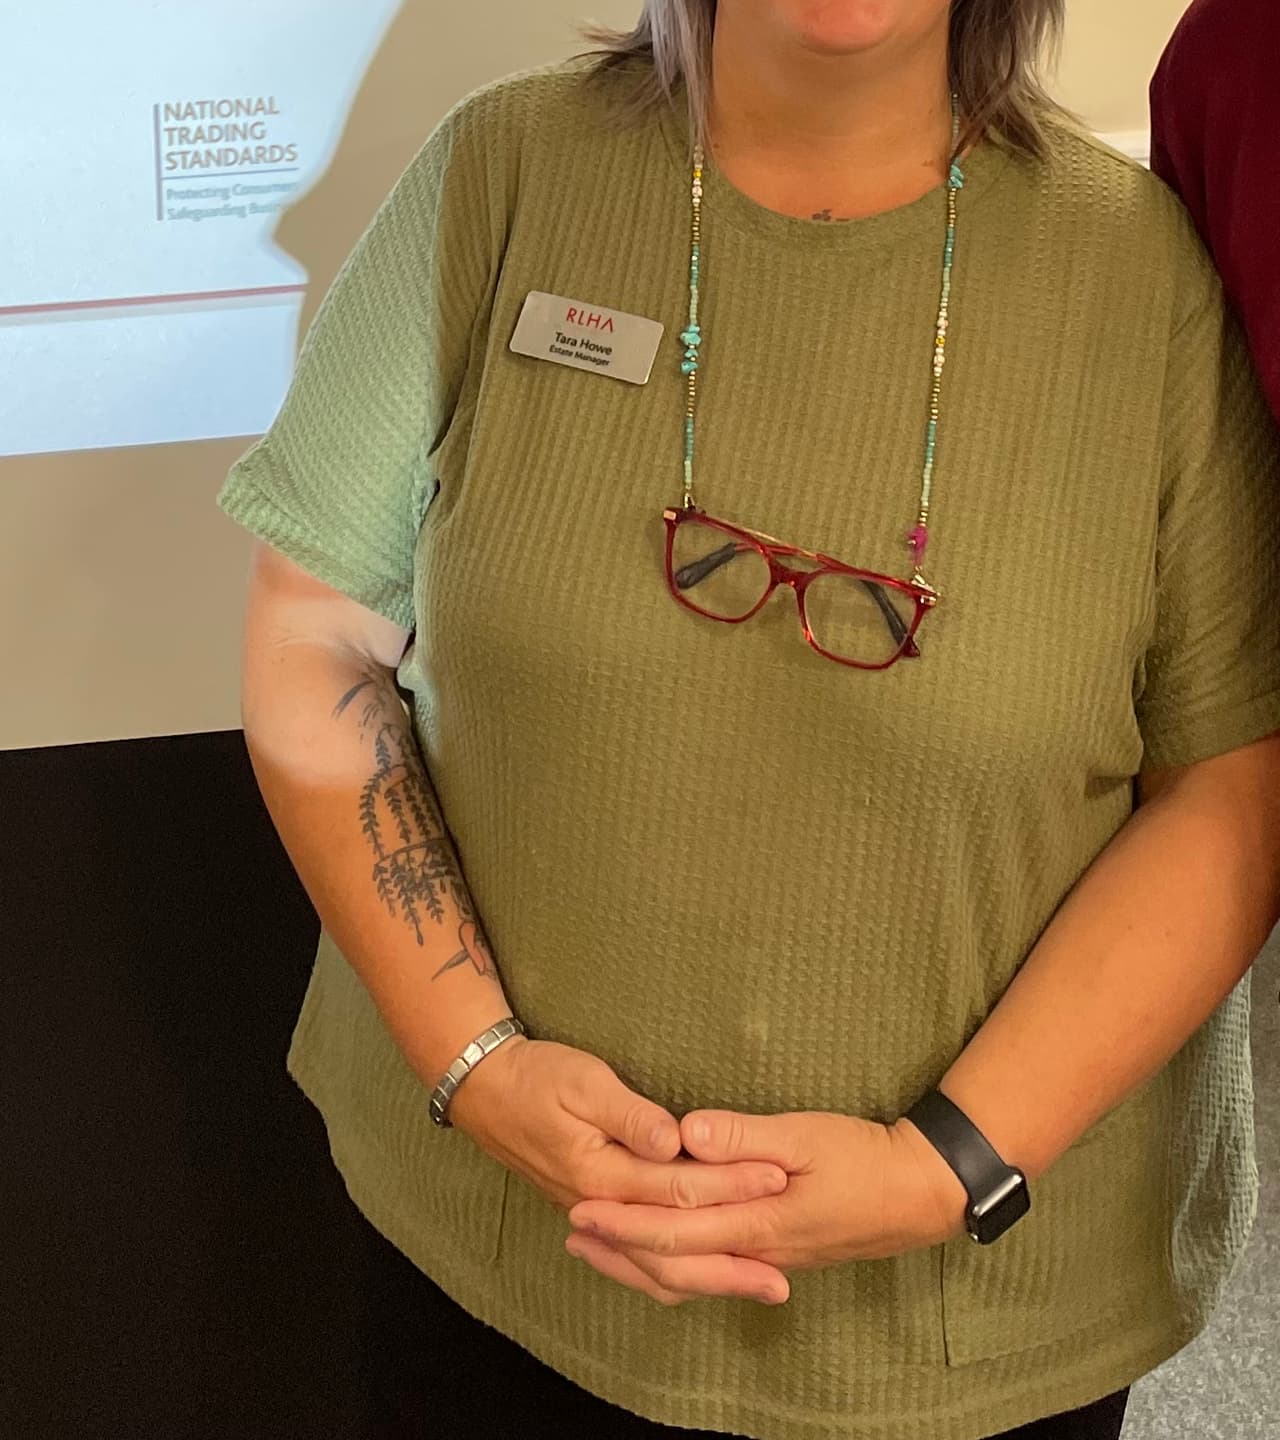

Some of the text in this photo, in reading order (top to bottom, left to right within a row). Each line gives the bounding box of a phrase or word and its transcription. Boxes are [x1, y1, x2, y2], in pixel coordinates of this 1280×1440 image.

[163, 96, 280, 122] NATIONAL
[164, 122, 267, 146] TRADING
[165, 143, 299, 171] STANDARDS
[565, 307, 614, 332] RLHA
[555, 332, 613, 356] Tara Howe
[574, 351, 610, 367] Manager
